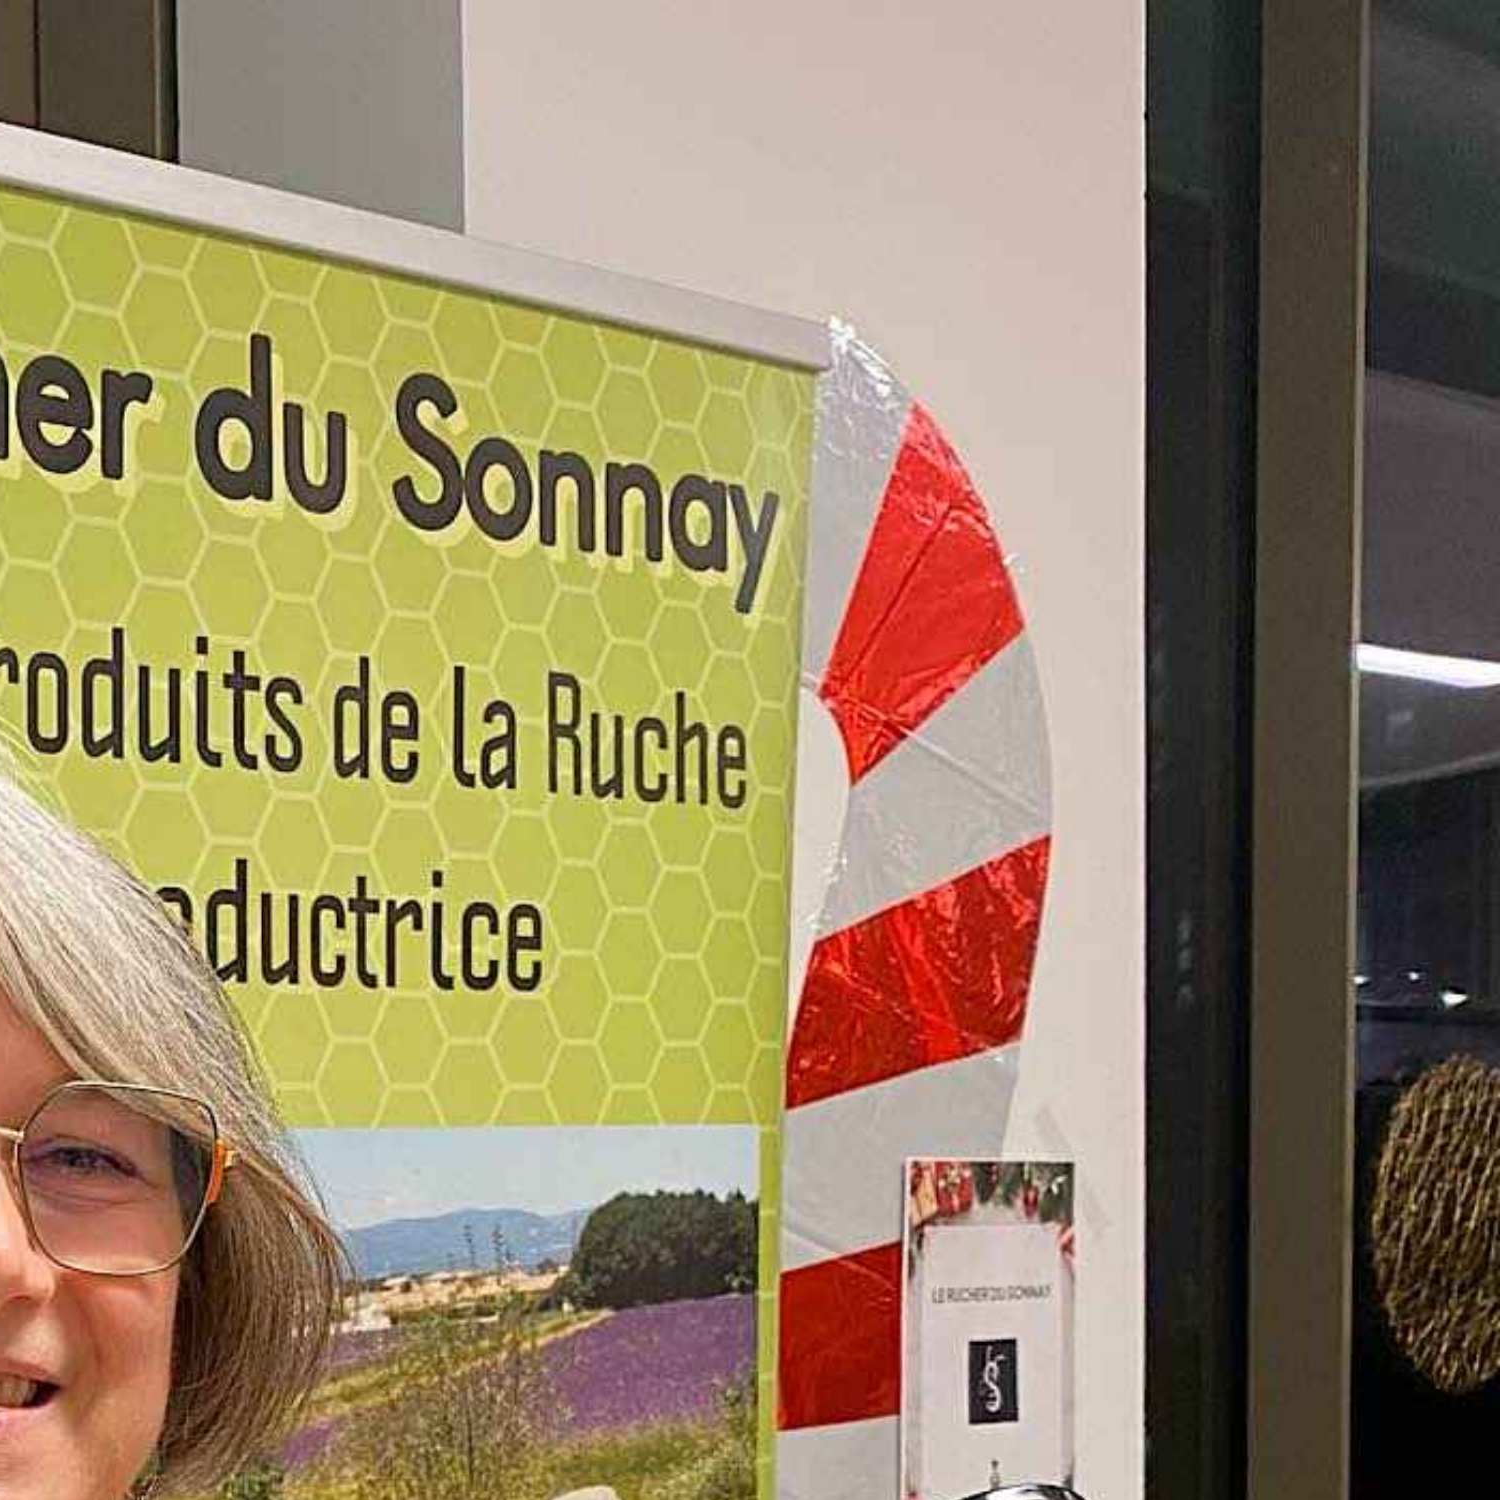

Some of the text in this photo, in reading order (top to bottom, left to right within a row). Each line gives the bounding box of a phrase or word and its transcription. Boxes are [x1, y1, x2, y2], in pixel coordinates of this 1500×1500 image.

[194, 333, 348, 515] du
[391, 372, 780, 614] Sonnay
[333, 656, 421, 785] de
[452, 665, 518, 791] la
[547, 671, 748, 810] Ruche
